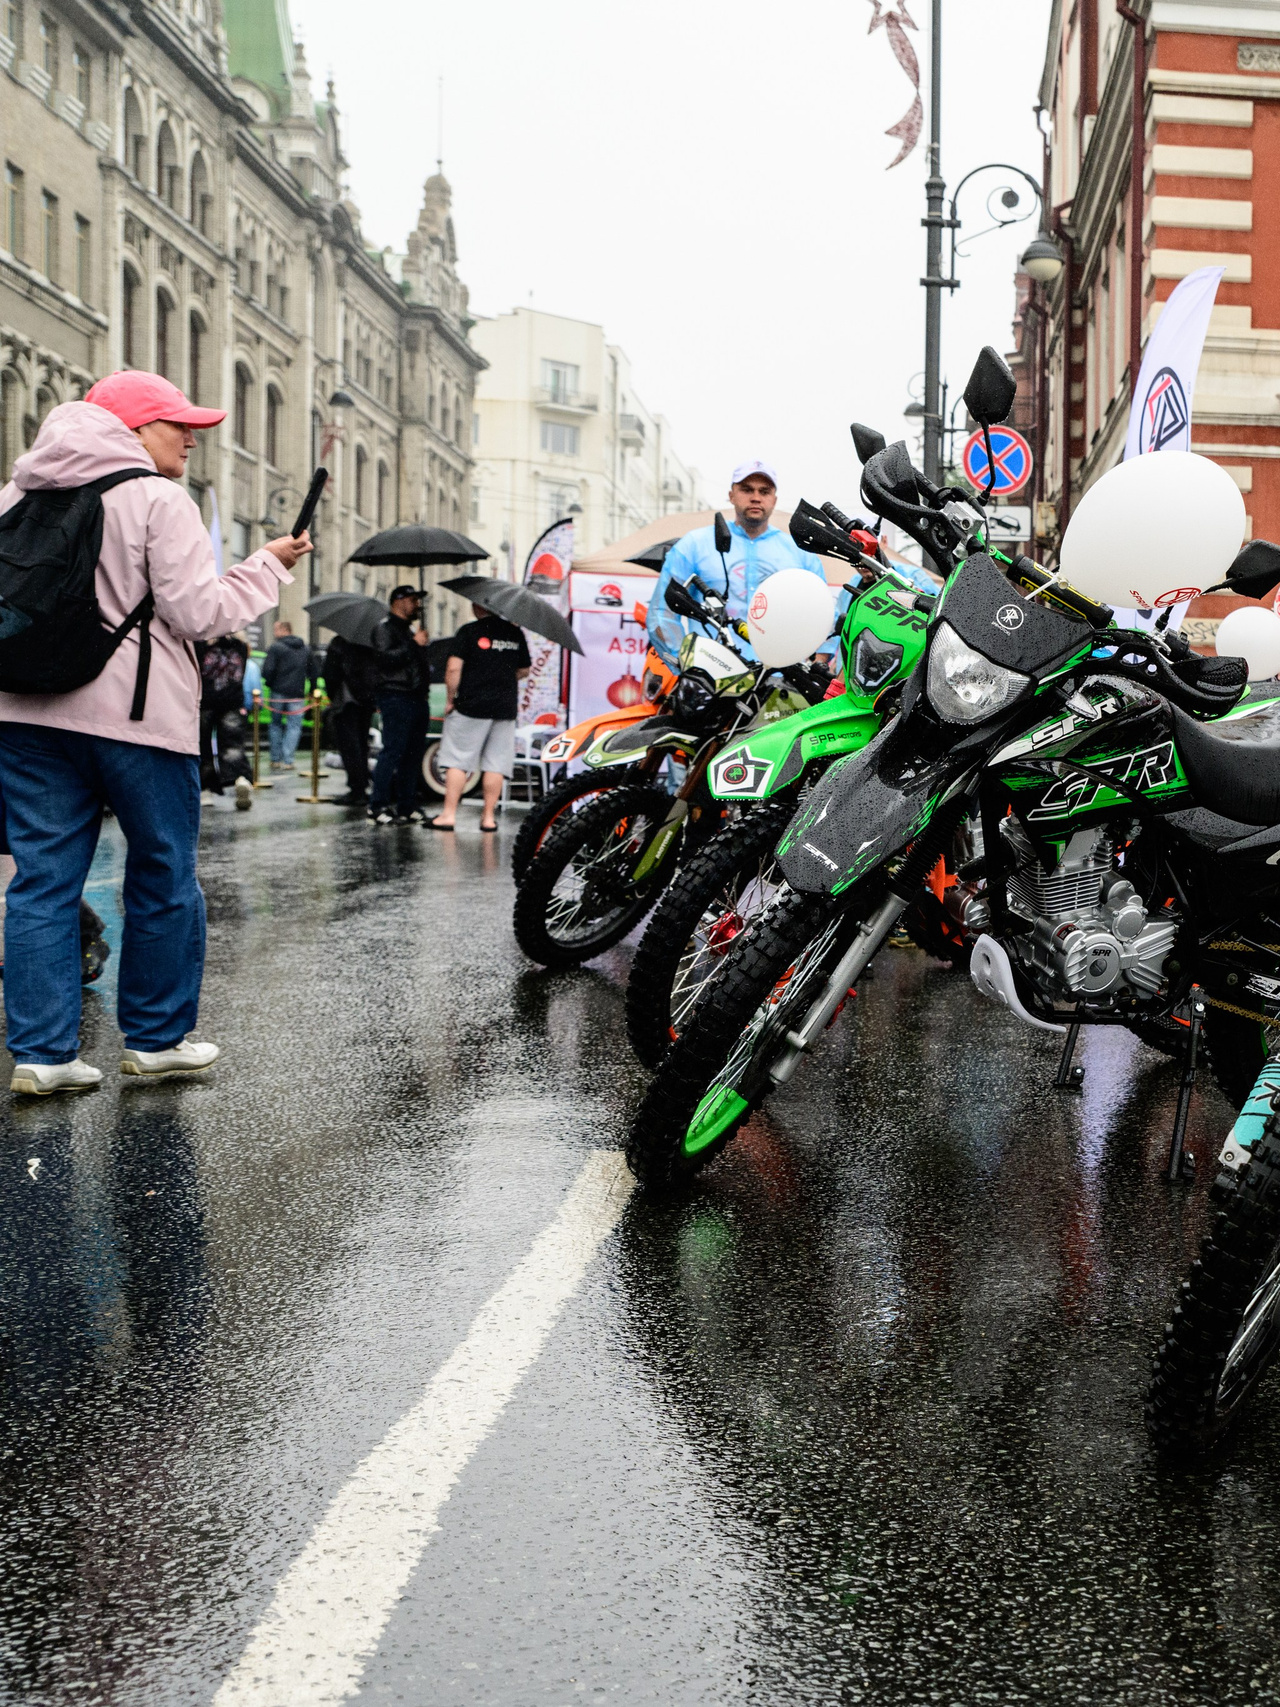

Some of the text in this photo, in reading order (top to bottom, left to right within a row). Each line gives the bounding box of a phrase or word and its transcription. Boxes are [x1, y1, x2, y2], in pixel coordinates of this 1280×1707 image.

[863, 596, 927, 633] SPR
[809, 732, 836, 745] SPR
[1027, 740, 1174, 821] SPR
[1091, 949, 1111, 957] SPR
